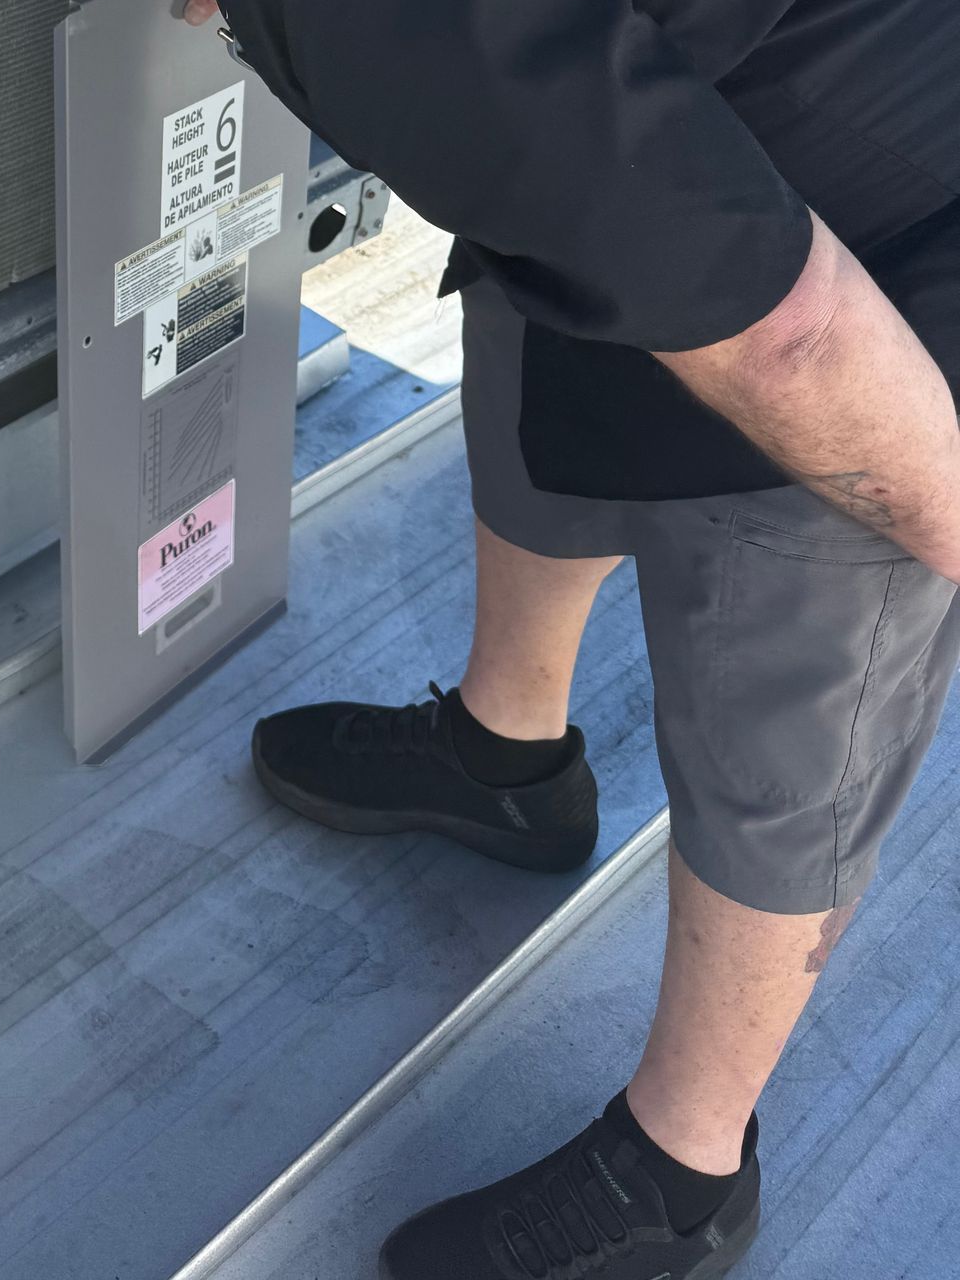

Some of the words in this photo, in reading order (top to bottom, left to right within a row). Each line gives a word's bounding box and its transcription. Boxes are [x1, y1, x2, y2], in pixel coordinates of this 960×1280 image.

[174, 107, 203, 132] STACK
[216, 97, 236, 152] 6
[172, 122, 205, 150] HEIGHT
[167, 144, 208, 175] HAUTEUR
[171, 170, 183, 188] DE
[185, 160, 204, 181] PILE
[164, 212, 175, 229] DE
[177, 181, 234, 221] APILAMIENTO
[169, 183, 203, 211] ALTURA
[238, 183, 269, 206] WARNING
[128, 229, 183, 266] AVERTISSEMENT
[198, 260, 236, 285] WARNING
[186, 296, 243, 337] AVERTISSEMENT
